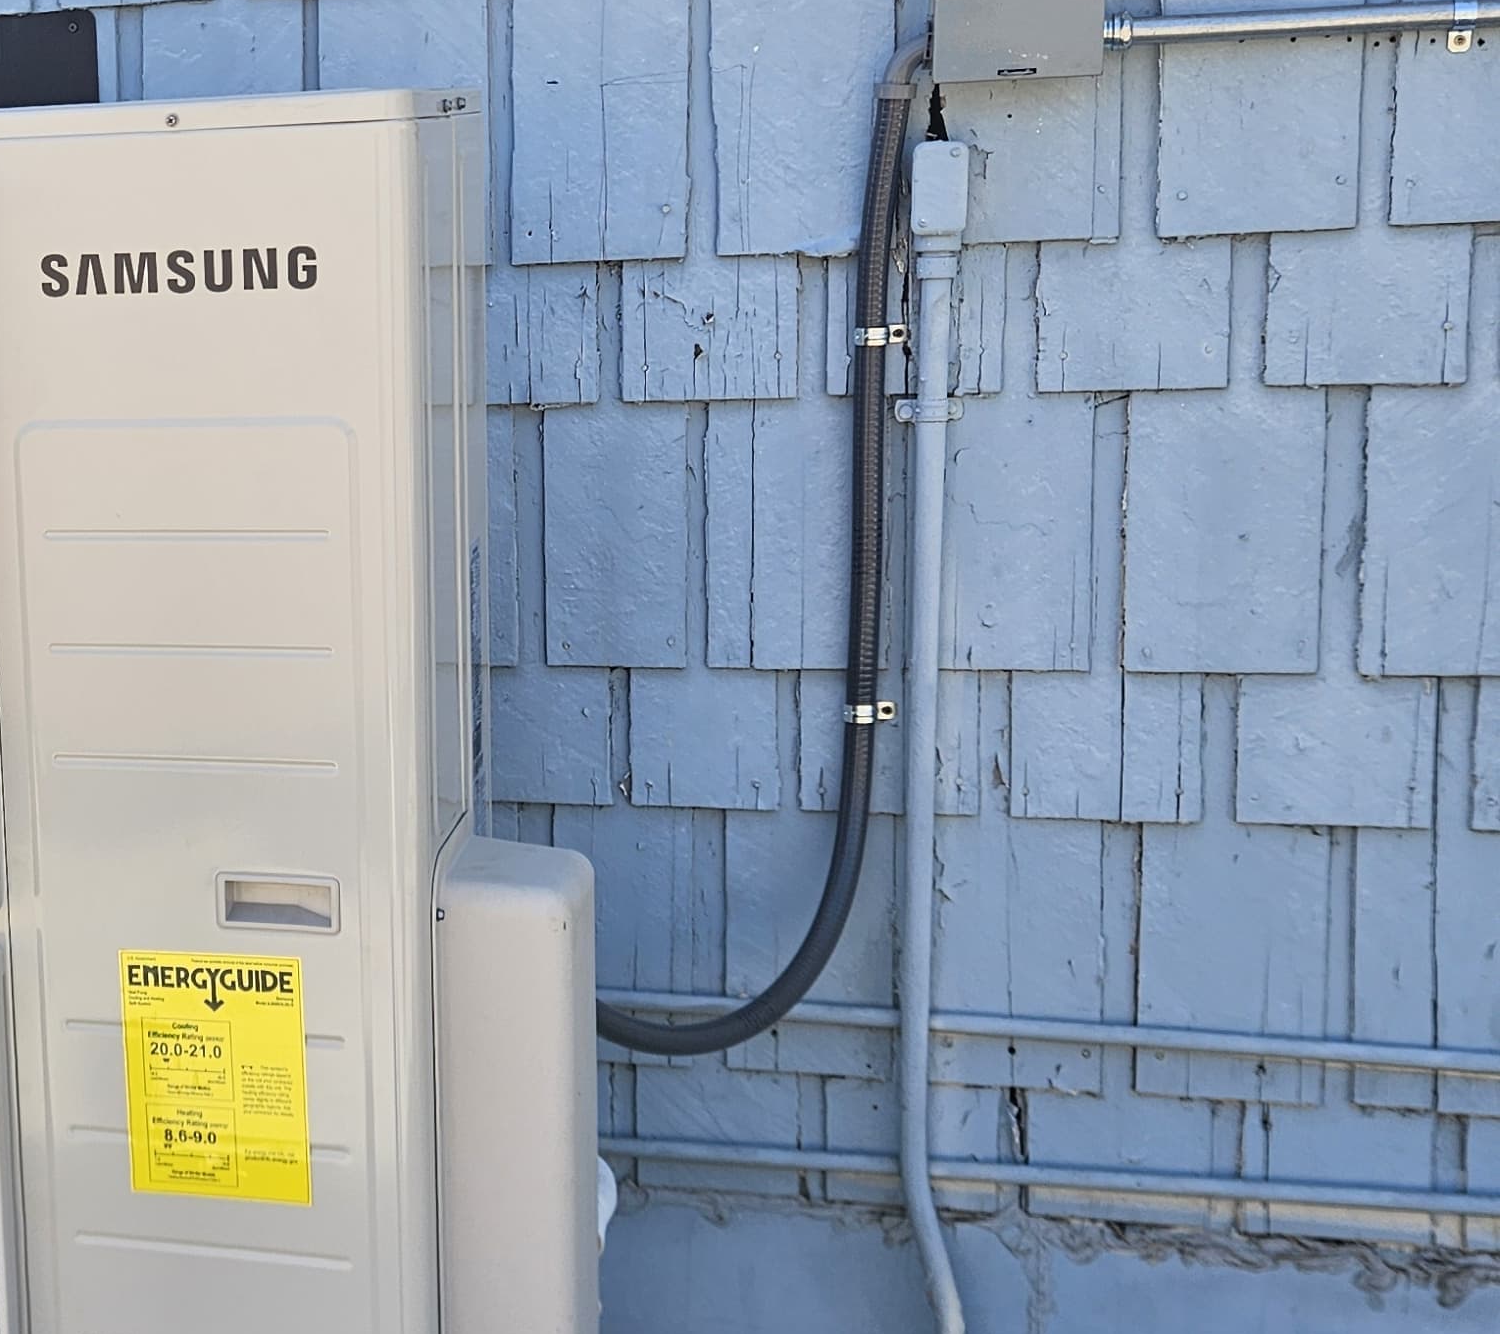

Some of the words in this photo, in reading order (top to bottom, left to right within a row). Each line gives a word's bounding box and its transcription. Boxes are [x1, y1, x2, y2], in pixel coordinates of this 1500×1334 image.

[41, 245, 318, 298] SAMSUNG
[127, 964, 294, 995] ENERGYGUIDE
[171, 1022, 199, 1032] Cooling
[147, 1031, 180, 1041] Efficiency
[181, 1033, 204, 1042] Rating
[150, 1042, 222, 1059] 20.0-21.0
[152, 1116, 184, 1127] Efficiency
[186, 1119, 208, 1129] Rating
[164, 1128, 217, 1145] 8.6-9.0
